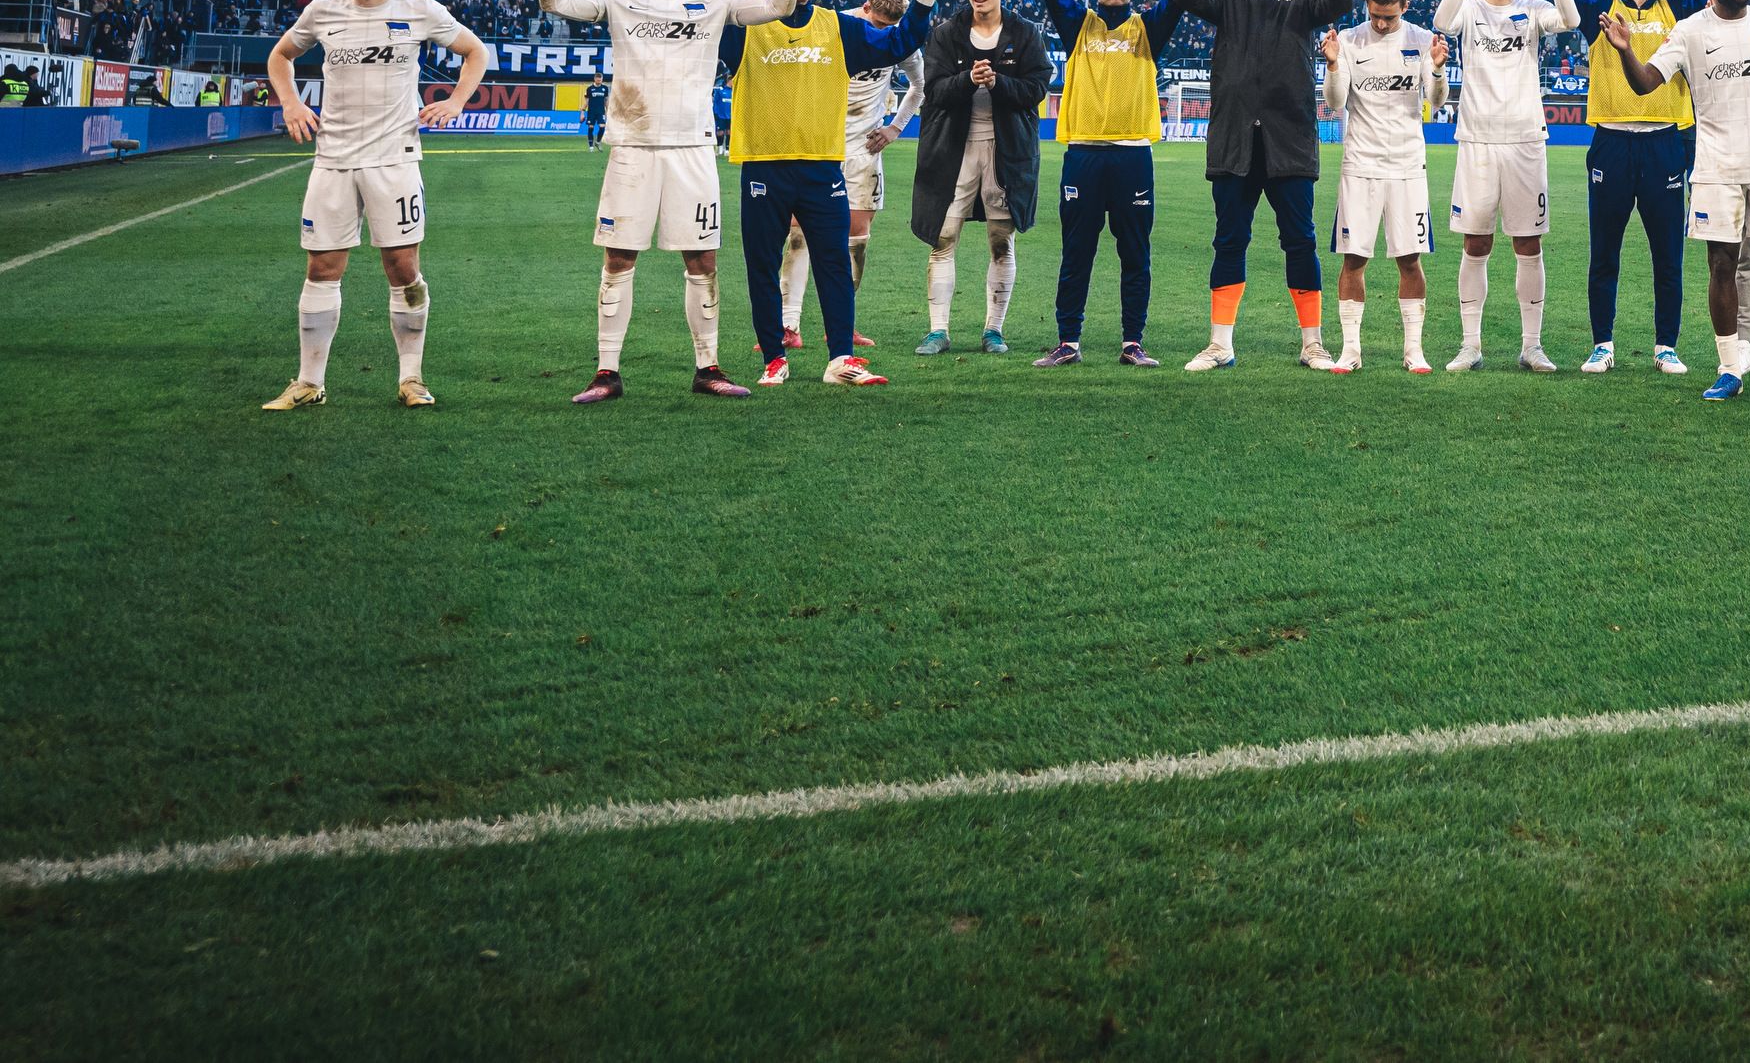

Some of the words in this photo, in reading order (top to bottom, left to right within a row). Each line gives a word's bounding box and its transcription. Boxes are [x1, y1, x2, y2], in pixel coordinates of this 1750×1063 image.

[503, 113, 550, 129] Kleiner
[396, 194, 420, 226] 16
[695, 202, 719, 231] 41
[1538, 193, 1546, 218] 9
